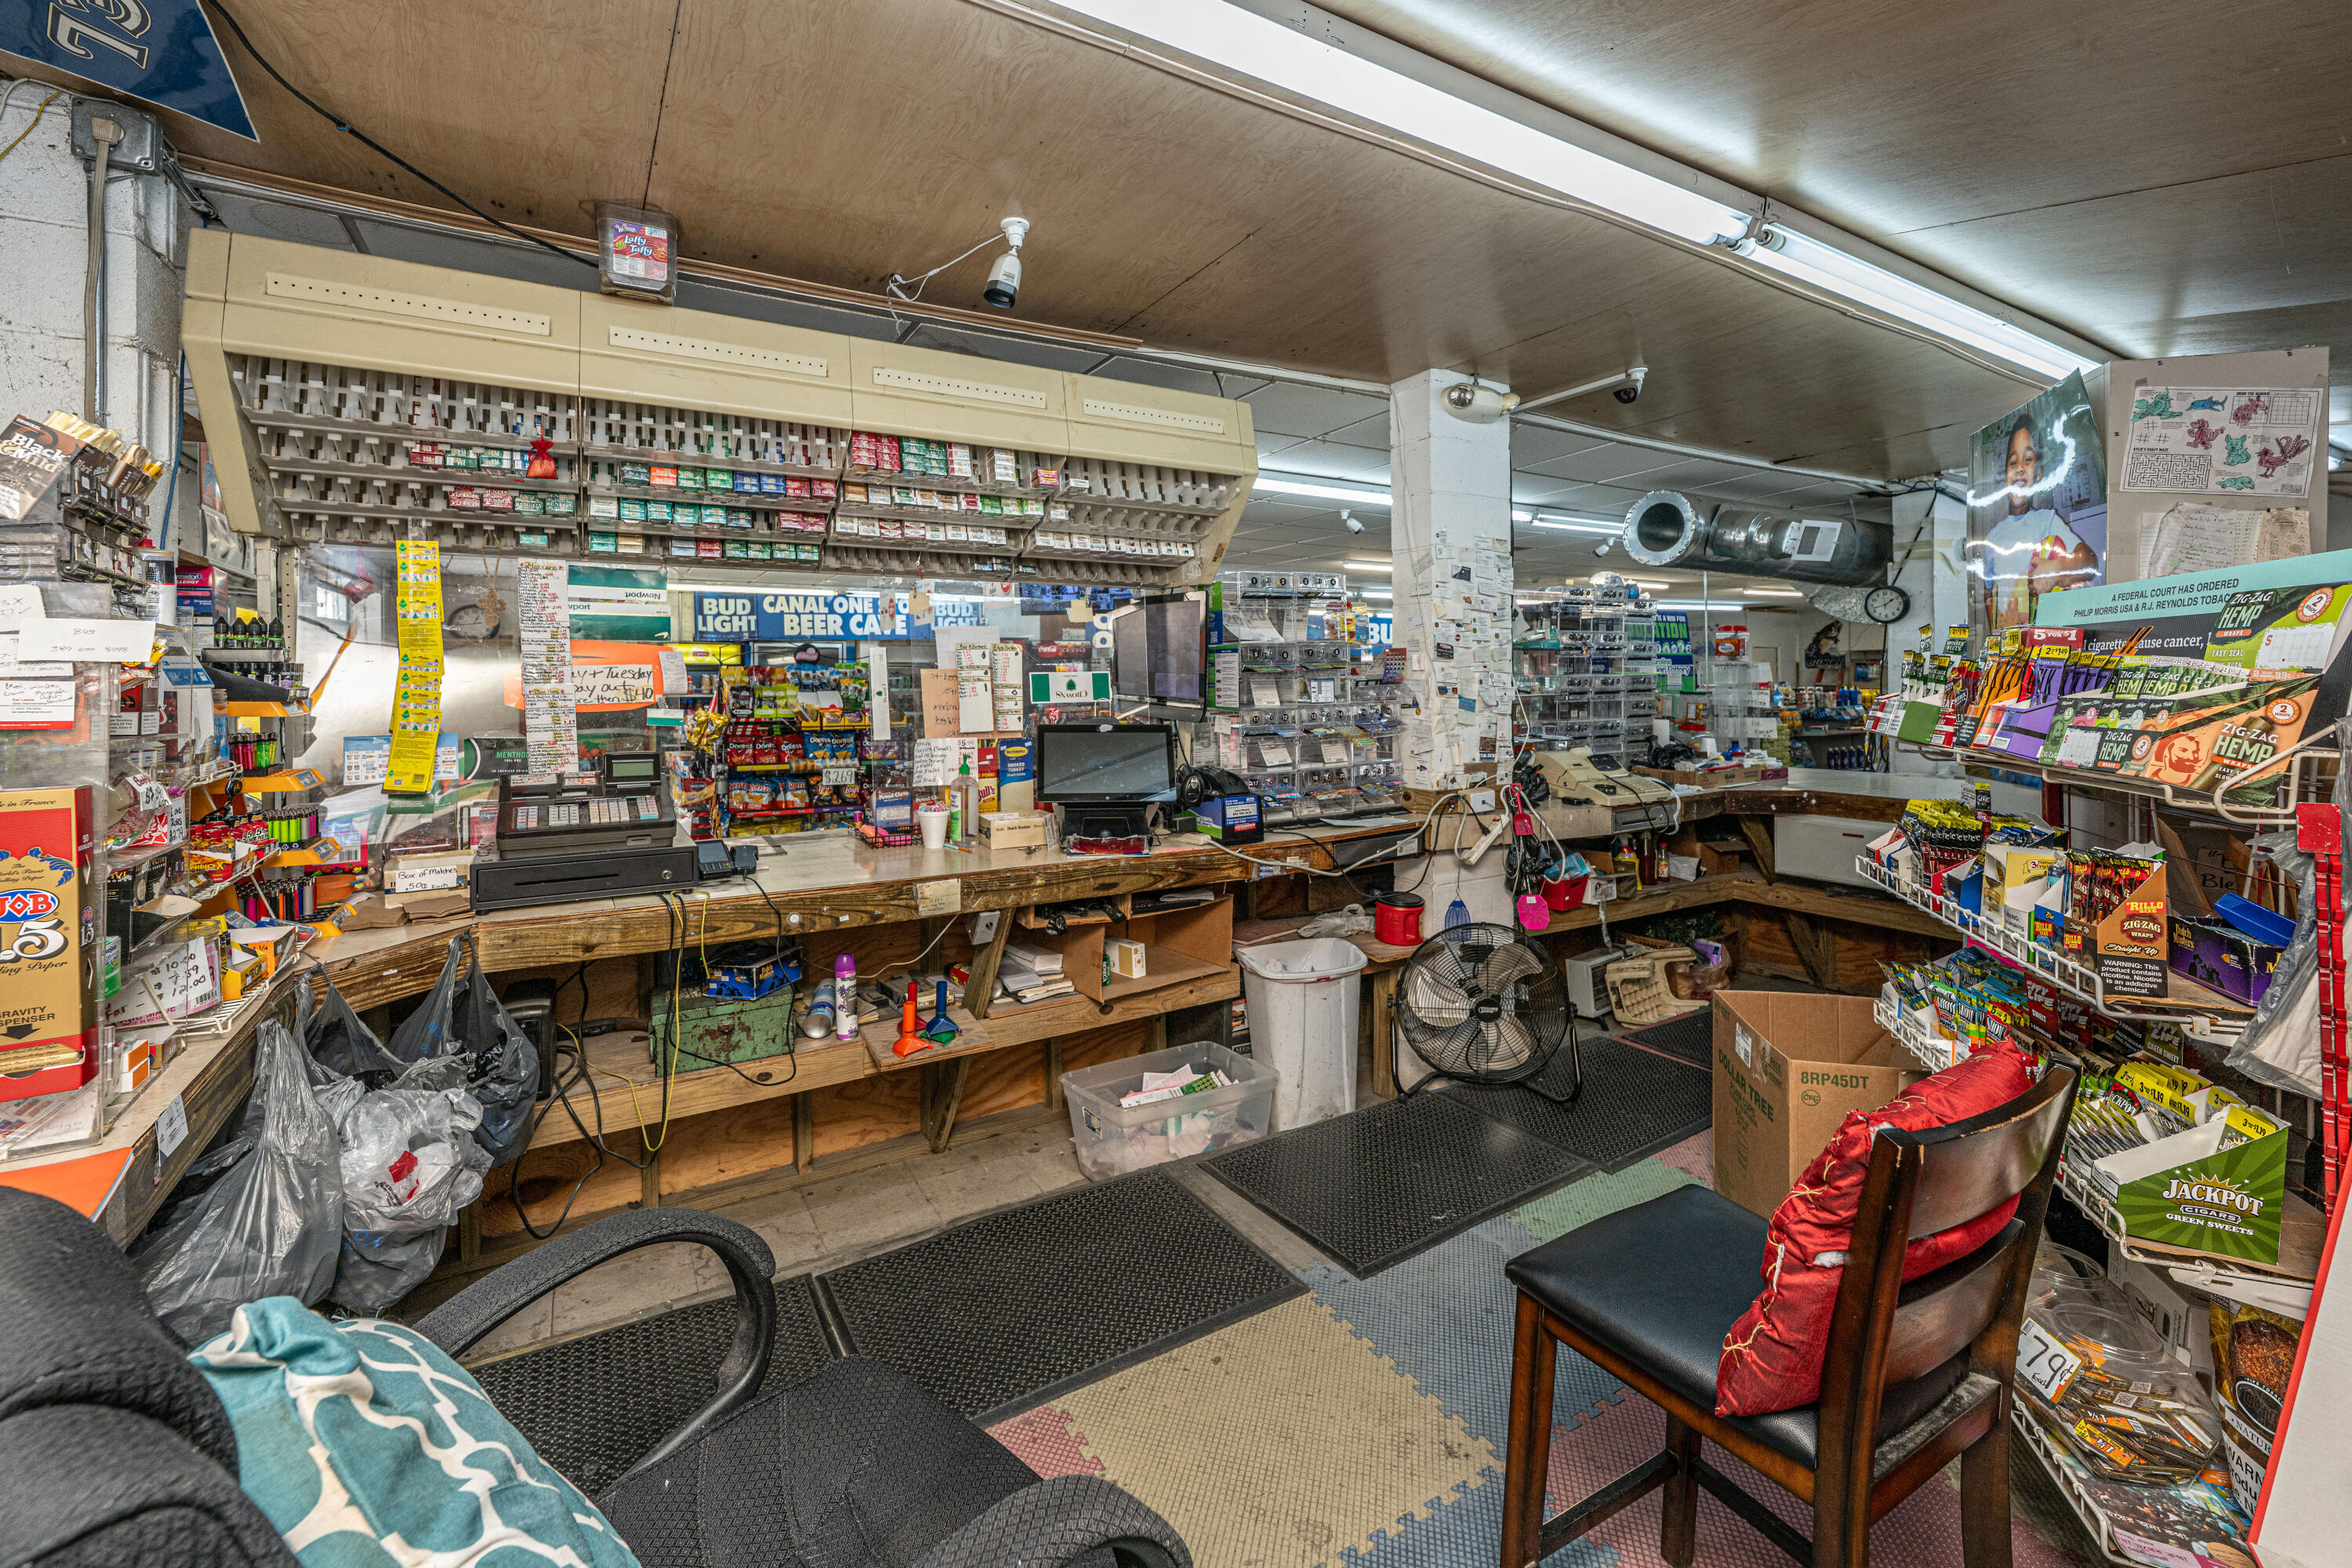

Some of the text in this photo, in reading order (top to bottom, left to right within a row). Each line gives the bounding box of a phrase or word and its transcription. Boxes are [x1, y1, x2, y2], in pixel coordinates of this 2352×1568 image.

[624, 235, 647, 245] Laffy
[630, 244, 654, 256] Taffy
[11, 433, 67, 461] Black
[2118, 591, 2147, 601] FEDERAL
[2148, 587, 2176, 599] COURT
[2177, 584, 2195, 595] HAS
[2196, 578, 2240, 593] ORDERED
[763, 596, 873, 614] CANAL ONE
[2074, 592, 2230, 618] PHILIP MORRIS USA & R.J. REYNOLDS TOBAC
[2230, 592, 2274, 604] ZIG-ZAG
[2311, 596, 2322, 607] 2
[702, 598, 750, 615] BUD
[936, 602, 975, 618] BUD
[699, 615, 757, 633] LIGHT
[2218, 604, 2265, 629] HEMP
[784, 615, 844, 636] BEER
[2033, 629, 2048, 640] 5
[2063, 630, 2077, 641] $1
[2164, 635, 2204, 650] cancer,
[603, 666, 652, 682] Tuesday
[1668, 666, 1690, 677] Lottery
[2147, 671, 2180, 681] ZIG-ZAG
[623, 686, 654, 702] $40
[2143, 680, 2176, 695] HEMP
[2105, 731, 2132, 742] ZIG-ZAG
[2221, 723, 2280, 745] ZIG-ZAG
[2099, 742, 2129, 761] HEMP
[2212, 735, 2274, 761] HEMP
[2223, 758, 2252, 770] WRAPS
[825, 770, 854, 784] $2.69
[22, 798, 56, 807] France
[419, 869, 427, 878] of
[428, 866, 457, 877] Matches
[2123, 920, 2161, 934] ZIG-ZAG
[2176, 923, 2192, 938] Dutch
[2173, 931, 2194, 949] Masters
[2104, 943, 2158, 956] Straight Up
[26, 960, 68, 973] Paper
[761, 964, 773, 975] Dutch
[2101, 966, 2130, 975] product
[2104, 959, 2143, 969] WARNING:
[2101, 971, 2162, 983] nicotine. Nicotine
[2125, 979, 2158, 989] addictive
[2114, 985, 2149, 994] chemical.
[2027, 990, 2054, 1007] LIFE
[2031, 1009, 2046, 1022] SWEET
[2151, 1029, 2180, 1047] LIFE
[2147, 1042, 2180, 1064] GREEN SWEET
[1800, 1071, 1870, 1089] 8RP45DT
[2120, 1071, 2127, 1080] 3
[2140, 1082, 2164, 1104] 3 $1.19
[2214, 1093, 2220, 1103] 3
[1748, 1084, 1774, 1123] TREE
[2242, 1119, 2267, 1137] 3 $1.19
[2162, 1178, 2263, 1217] JACKPOT
[2184, 1206, 2237, 1222] CIGARS
[2165, 1213, 2254, 1236] GREEN SWEETS
[2235, 1419, 2273, 1454] NATUR
